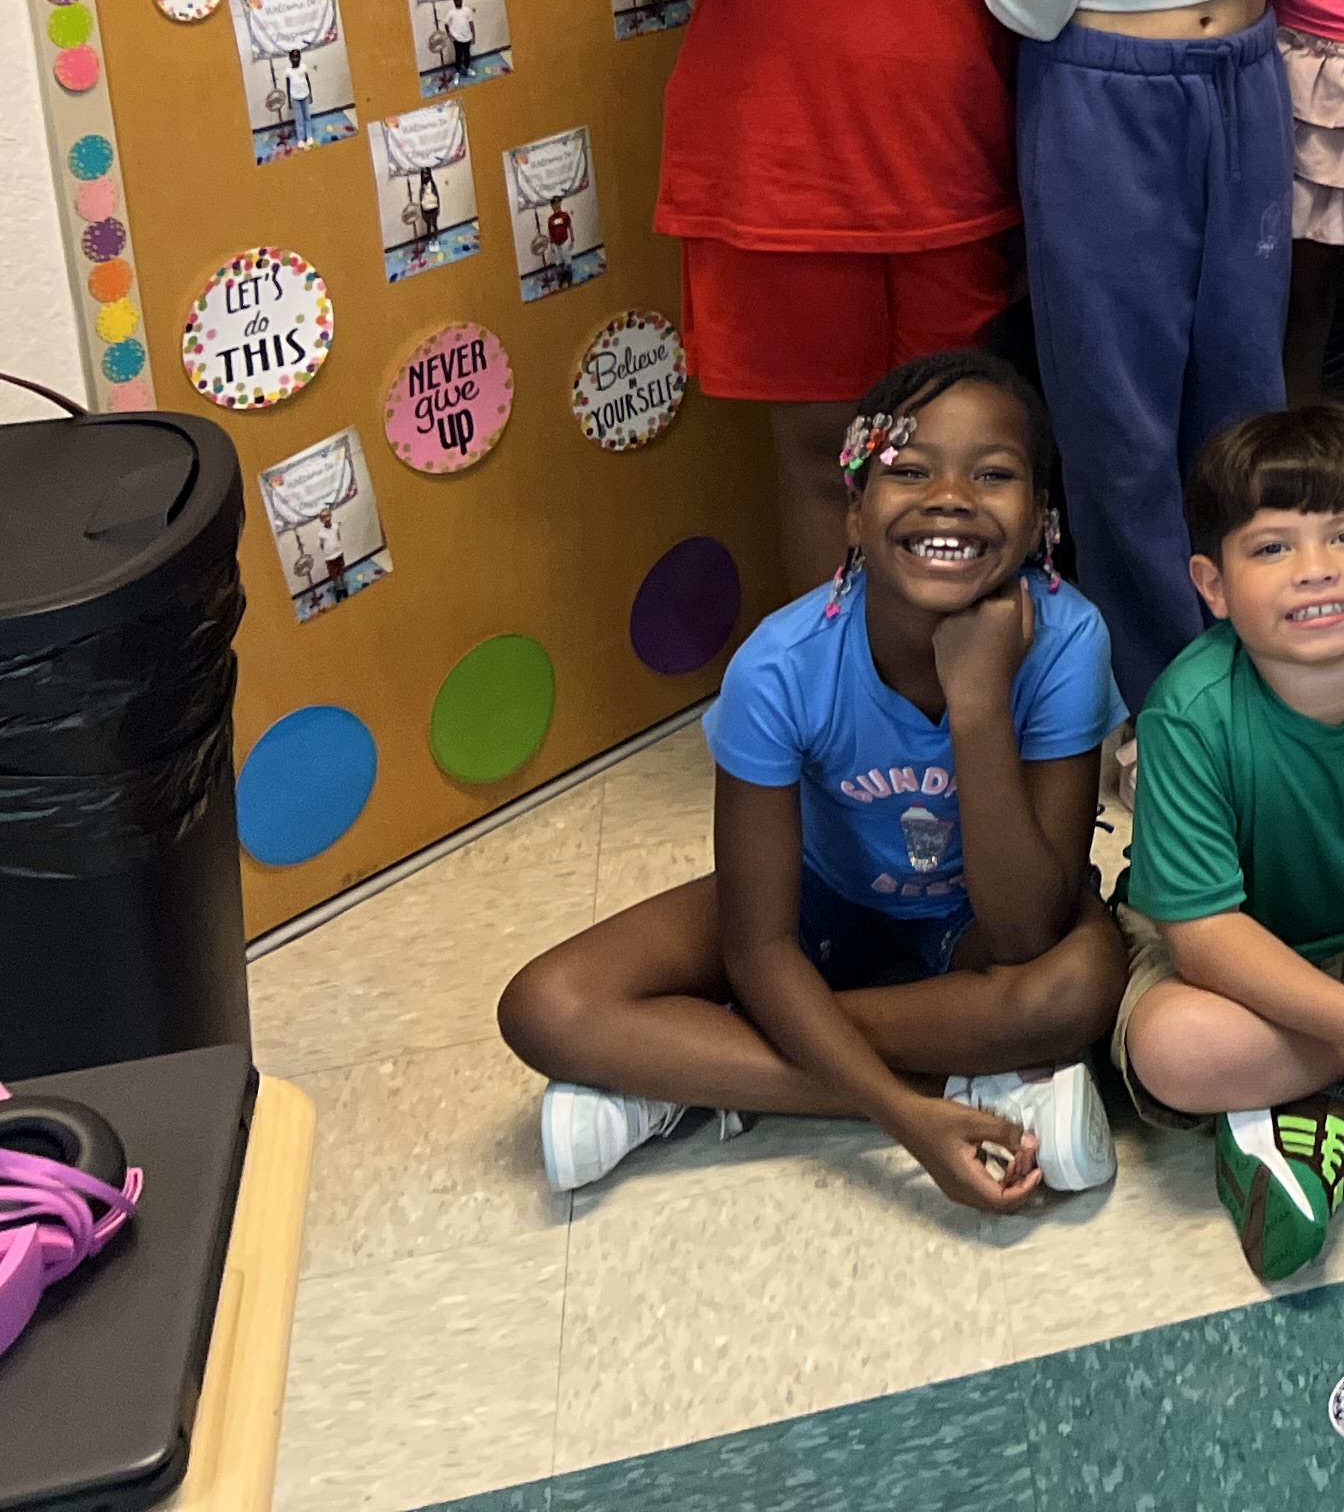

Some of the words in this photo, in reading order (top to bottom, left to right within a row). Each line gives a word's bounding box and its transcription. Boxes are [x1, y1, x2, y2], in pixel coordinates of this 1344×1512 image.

[226, 261, 283, 316] LET'S
[244, 310, 270, 337] do
[215, 328, 307, 384] THIS
[408, 339, 487, 399] NEVER
[588, 342, 669, 391] Believe
[414, 378, 480, 434] give
[591, 372, 675, 435] YOURSELF
[437, 408, 475, 456] up
[841, 767, 957, 803] SUND
